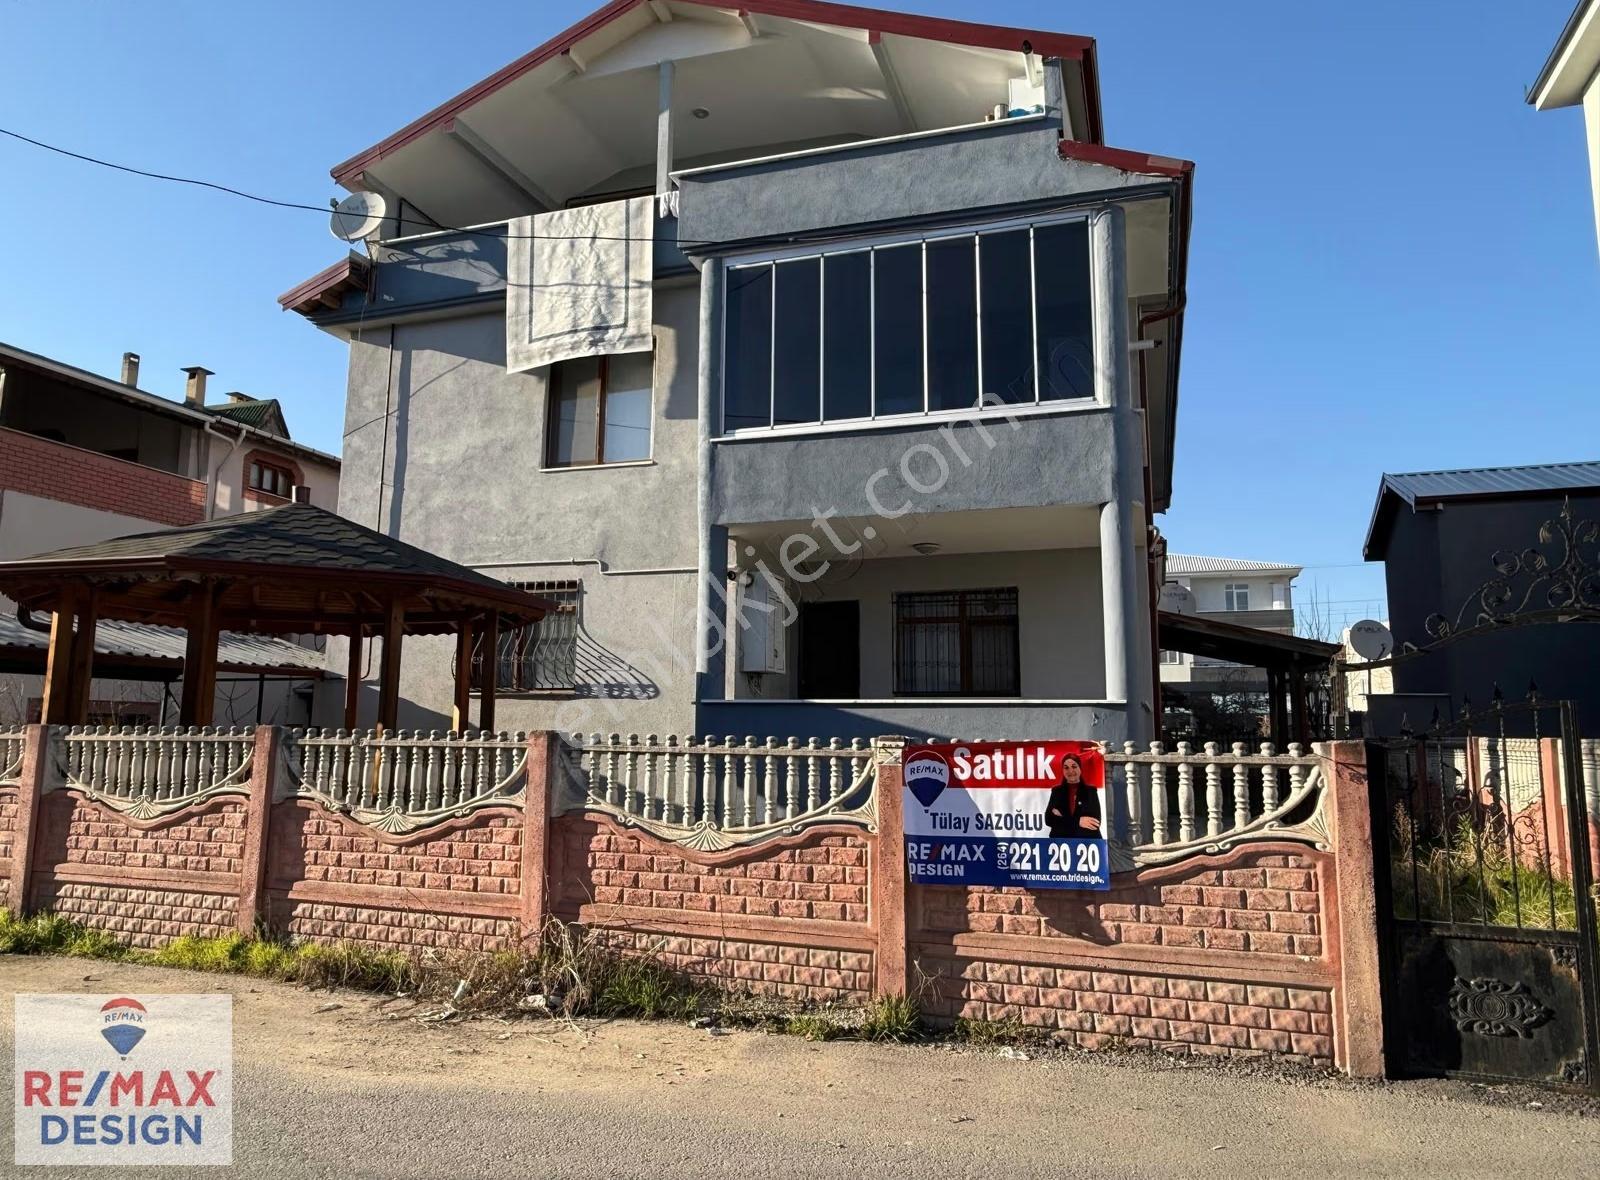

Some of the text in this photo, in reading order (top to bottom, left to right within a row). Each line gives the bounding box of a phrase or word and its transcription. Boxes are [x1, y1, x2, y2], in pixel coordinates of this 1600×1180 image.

[910, 765, 944, 776] RE/MAX
[953, 747, 1056, 780] Satılık
[930, 809, 1043, 834] Tülay SAZOĞLU
[907, 842, 986, 862] RE/MAX
[997, 842, 1100, 873] (264) 221 20 20
[909, 863, 965, 877] DESIGN
